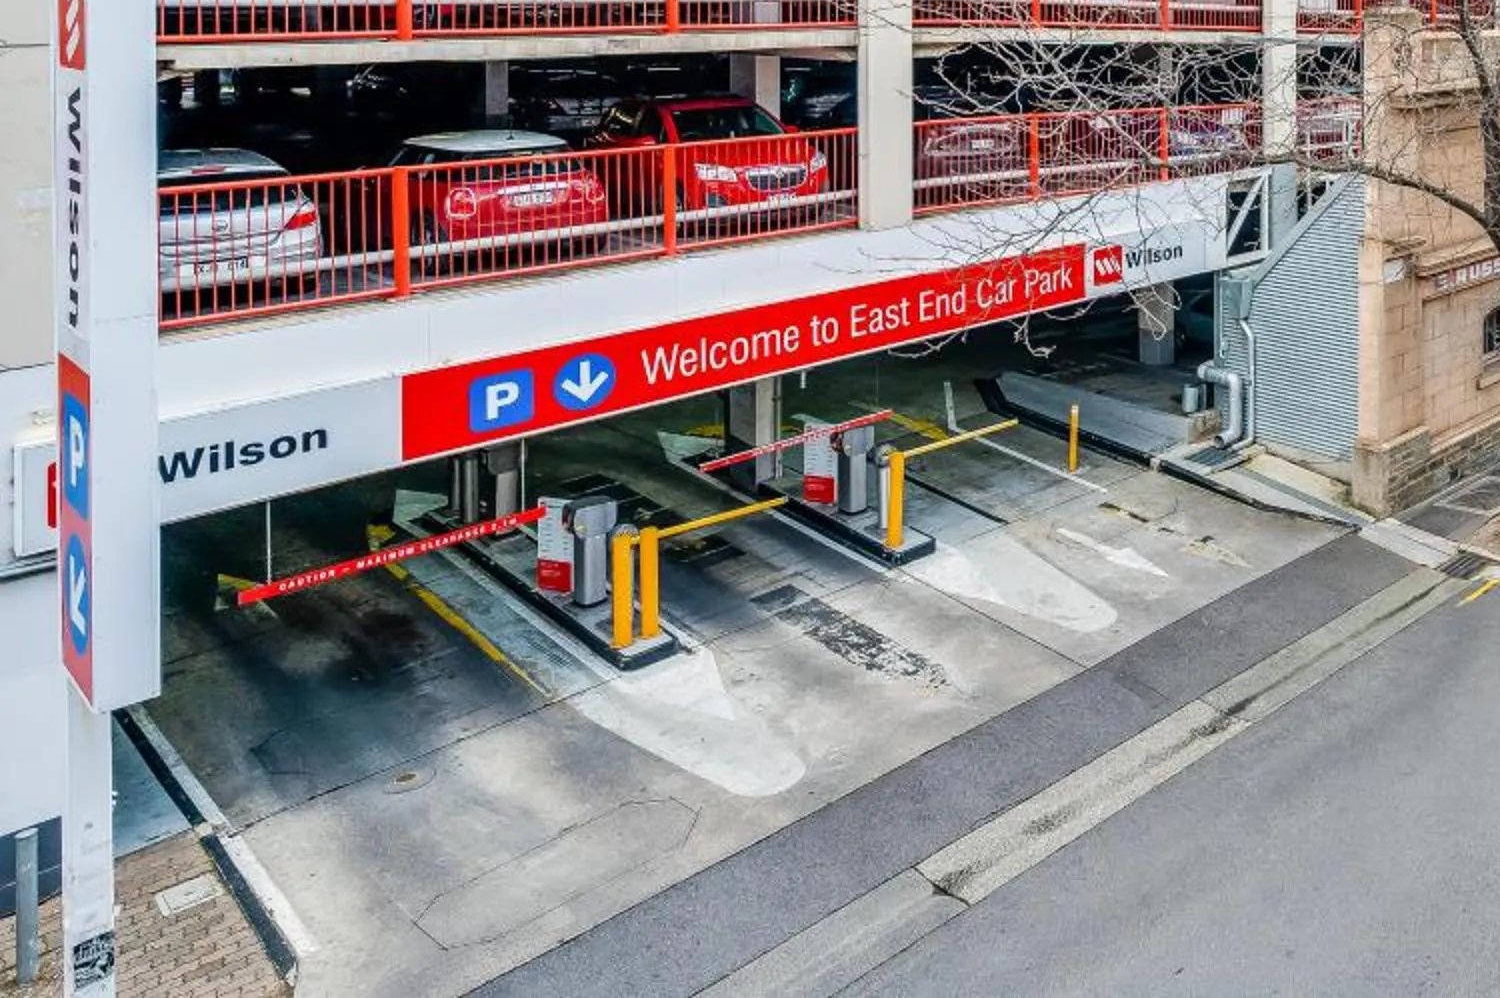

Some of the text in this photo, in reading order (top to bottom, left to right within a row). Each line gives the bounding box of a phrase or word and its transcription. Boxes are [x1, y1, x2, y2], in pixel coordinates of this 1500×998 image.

[67, 85, 82, 328] Wilson
[1125, 244, 1183, 269] Wilson
[641, 264, 1073, 385] Welcome to East End Car Park
[485, 381, 520, 421] P
[69, 414, 85, 487] P
[157, 426, 328, 484] Wilson
